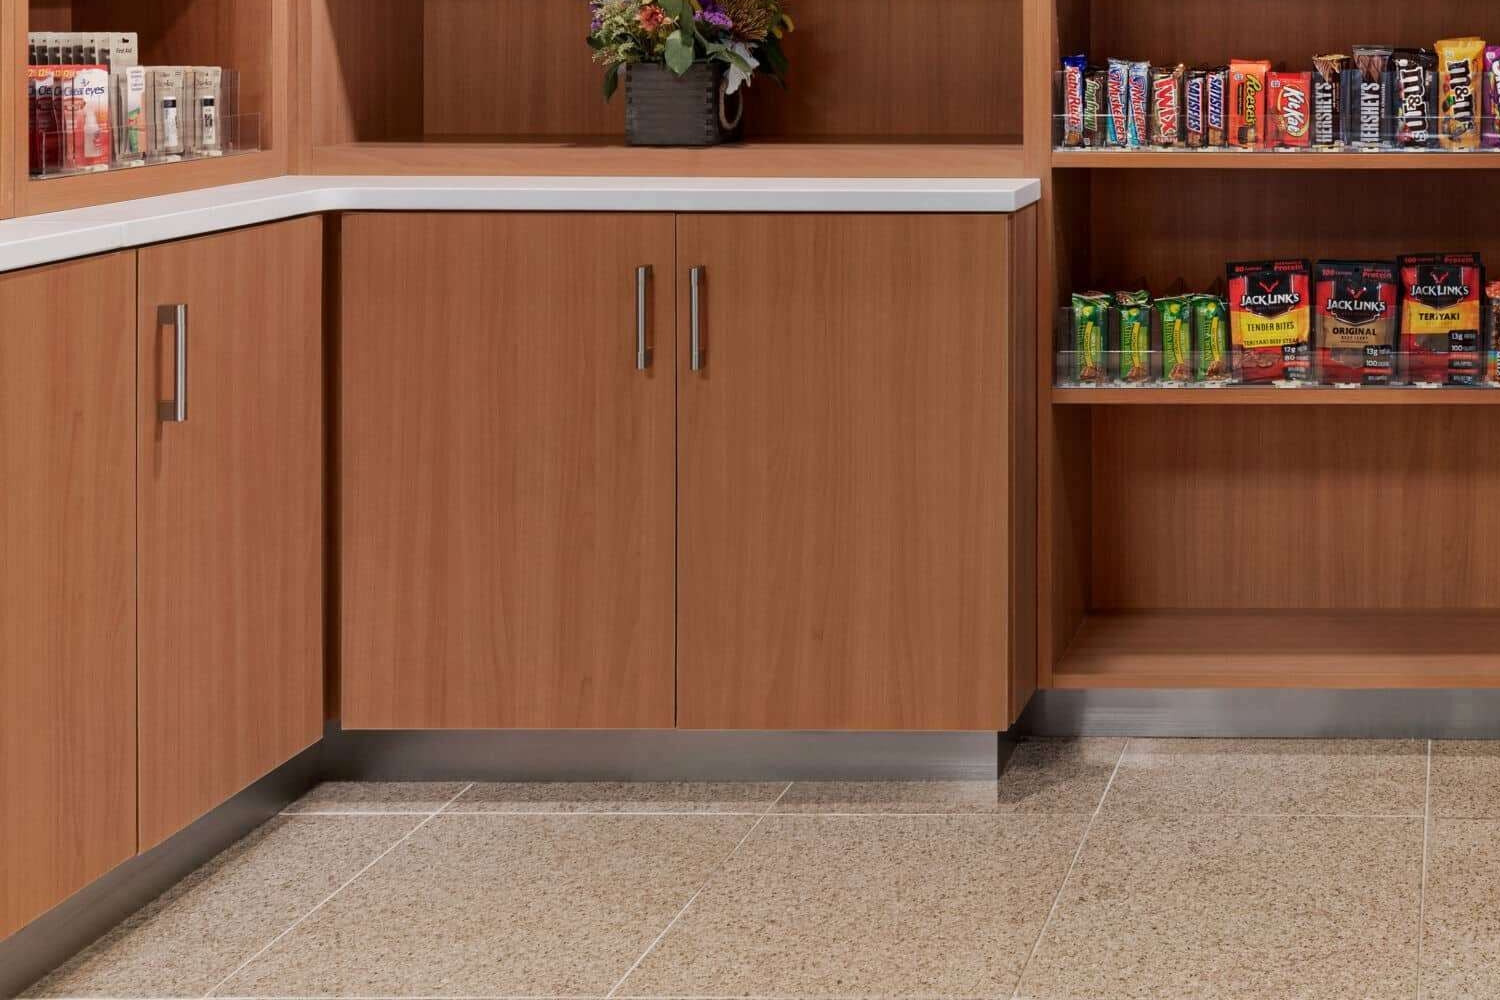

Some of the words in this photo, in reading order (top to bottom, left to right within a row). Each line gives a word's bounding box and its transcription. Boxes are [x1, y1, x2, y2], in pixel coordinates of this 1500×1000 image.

[85, 86, 105, 96] eyes
[1188, 79, 1200, 131] SATISFIES
[1209, 74, 1223, 127] SATISFIES
[1412, 285, 1435, 296] JACK
[1241, 295, 1266, 306] JACK
[1328, 300, 1352, 311] JACK
[1248, 323, 1274, 331] TENDER
[1276, 322, 1294, 330] BITES
